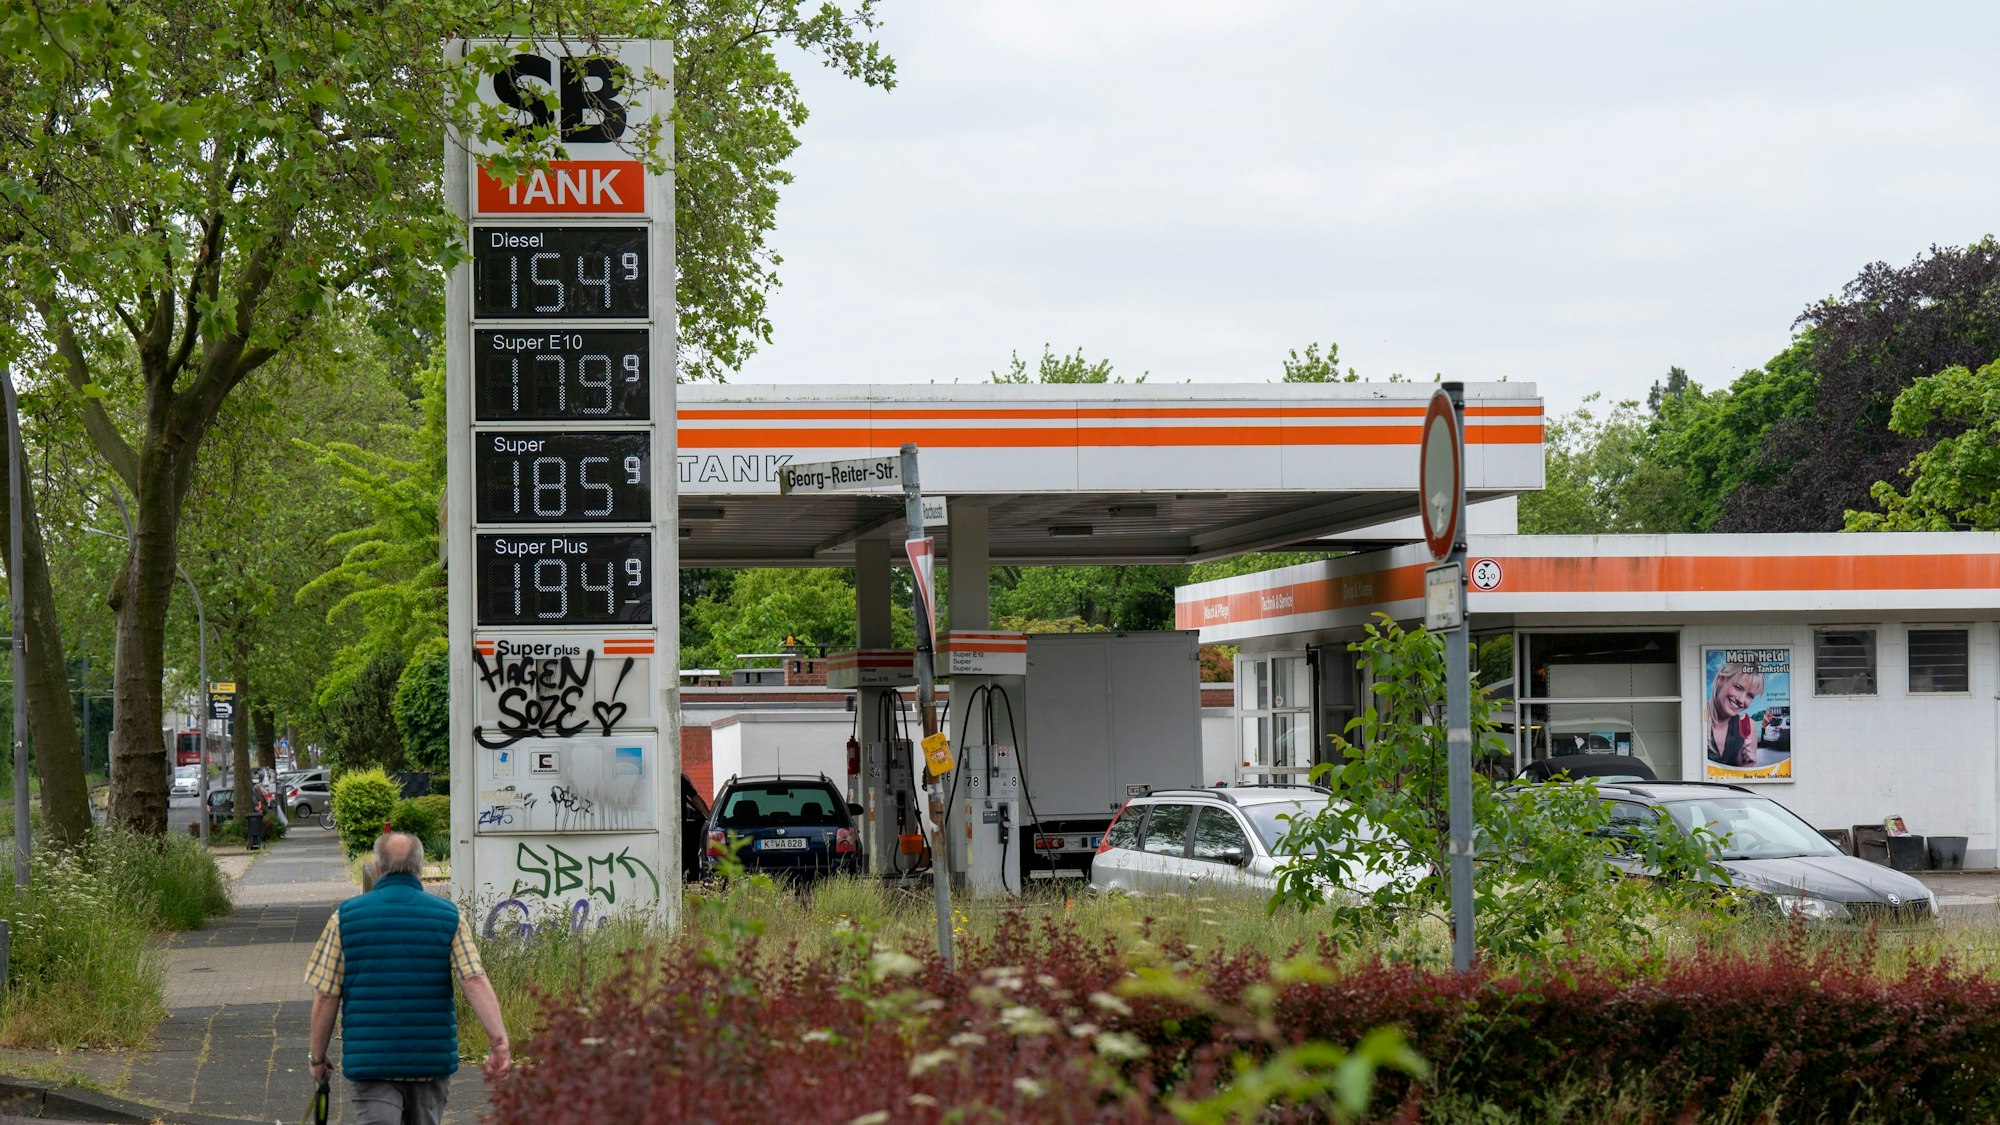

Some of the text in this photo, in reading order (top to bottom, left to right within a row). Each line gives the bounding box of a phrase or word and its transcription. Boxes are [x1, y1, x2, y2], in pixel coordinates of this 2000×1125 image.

[493, 54, 627, 144] SB
[505, 168, 623, 205] TANK
[491, 232, 544, 248] Diesel
[493, 334, 583, 353] Super E10
[494, 437, 545, 455] Super
[678, 455, 793, 482] TANK
[787, 462, 898, 490] Georg-Reiter-Str.
[495, 538, 588, 557] Super Plus
[1261, 595, 1276, 611] Technik
[1279, 593, 1293, 609] Service
[497, 639, 580, 659] Super plus
[1726, 649, 1784, 663] Mein Held
[1742, 665, 1755, 673] der
[973, 776, 979, 787] 8
[1011, 776, 1017, 787] 8
[764, 839, 770, 848] K
[787, 839, 803, 848] 828
